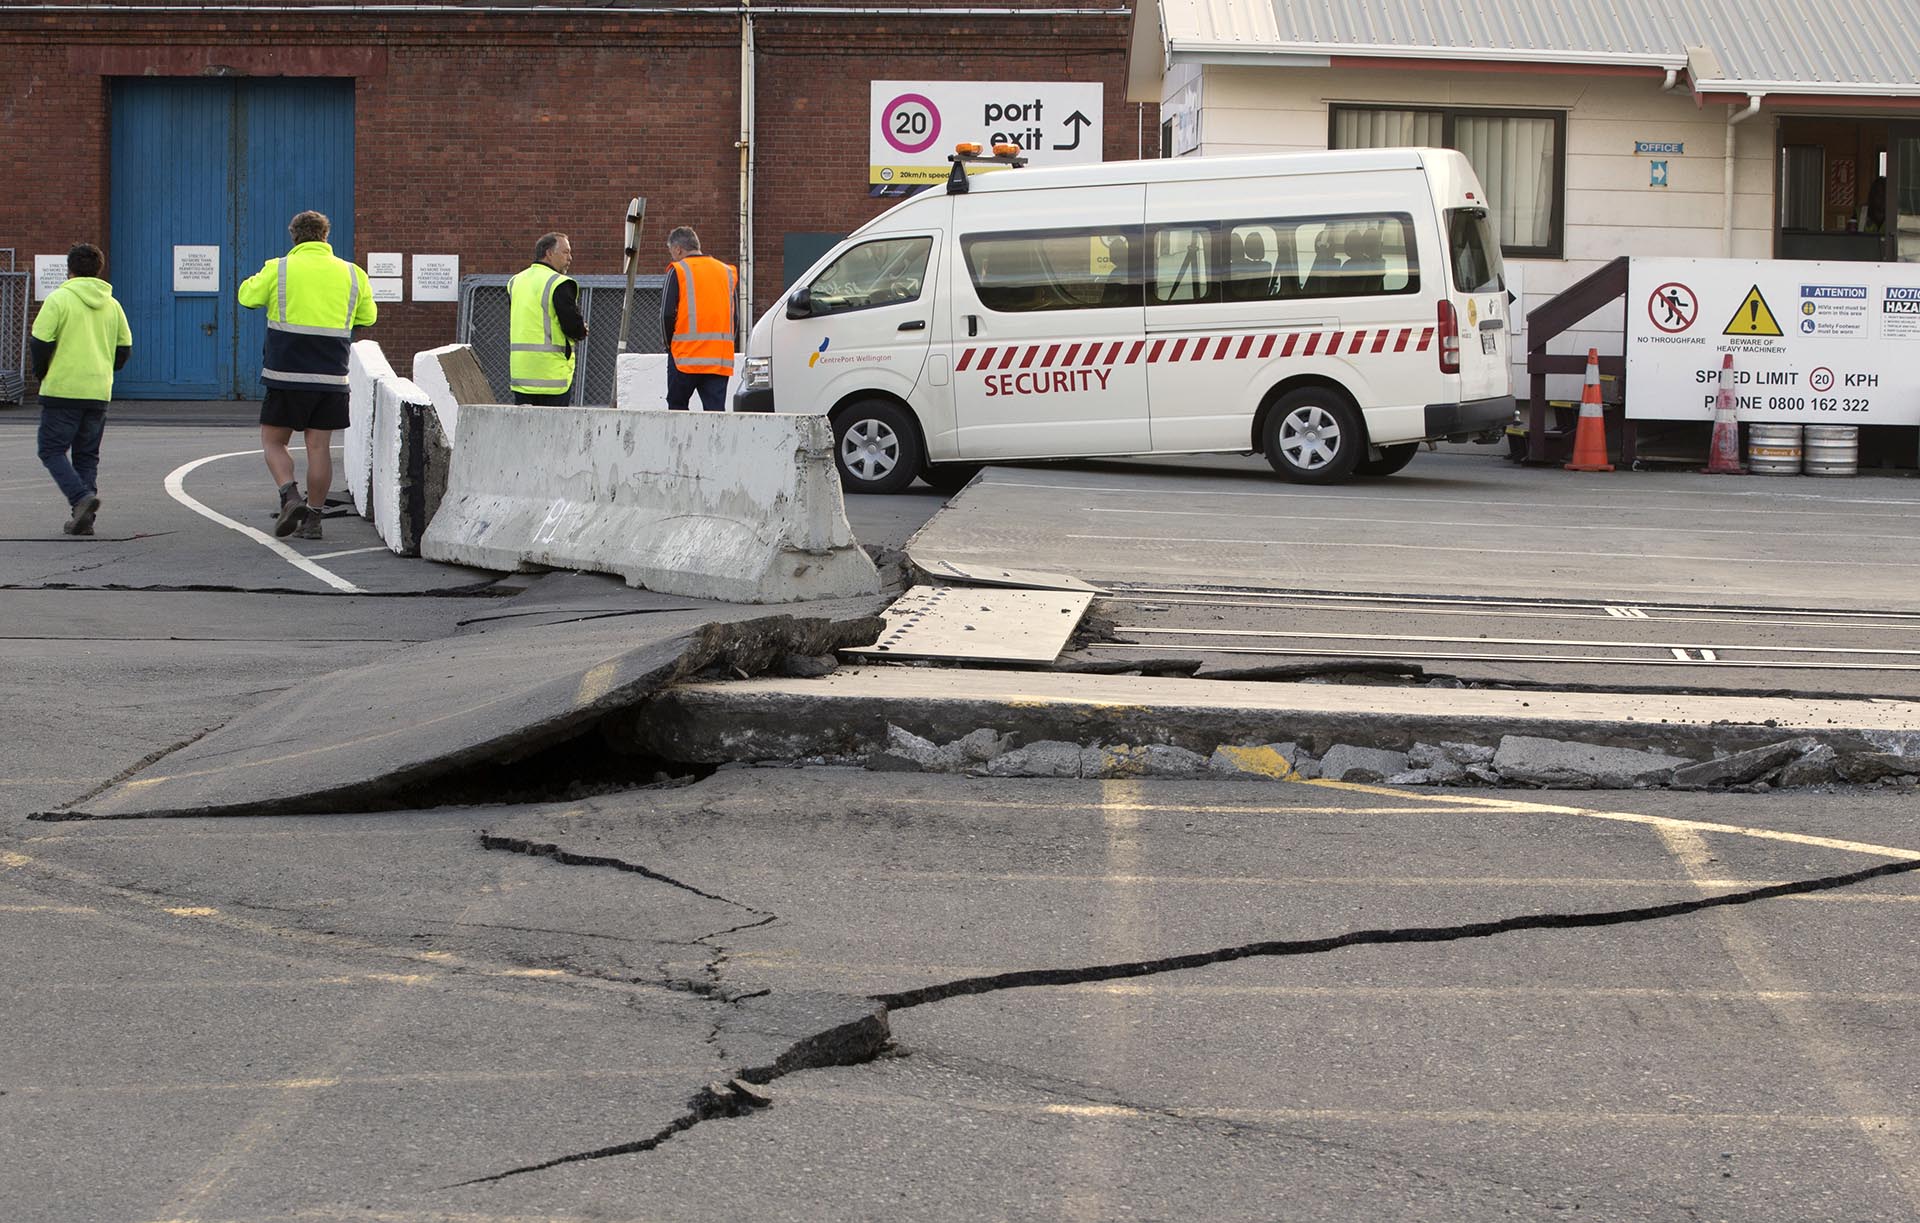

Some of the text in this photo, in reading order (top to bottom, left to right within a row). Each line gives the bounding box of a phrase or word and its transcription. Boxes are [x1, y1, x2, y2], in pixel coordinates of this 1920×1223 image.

[984, 99, 1043, 126] port
[896, 111, 927, 134] 20
[990, 128, 1043, 151] exit
[1640, 143, 1679, 152] OFFICE
[900, 171, 927, 179] 20km/h
[1814, 288, 1865, 297] ATTENTION
[1886, 301, 1920, 313] HAZA
[1637, 336, 1649, 344] NO
[1730, 338, 1762, 346] BEWARE
[1743, 346, 1787, 354] MACHINERY
[820, 355, 892, 364] CentrePort Wellington
[984, 368, 1112, 397] SECURITY
[1696, 370, 1799, 385] SPED LIMIT
[1814, 374, 1830, 385] 20
[1845, 374, 1879, 387] KPH
[1704, 396, 1869, 412] PNE 0800 162 322
